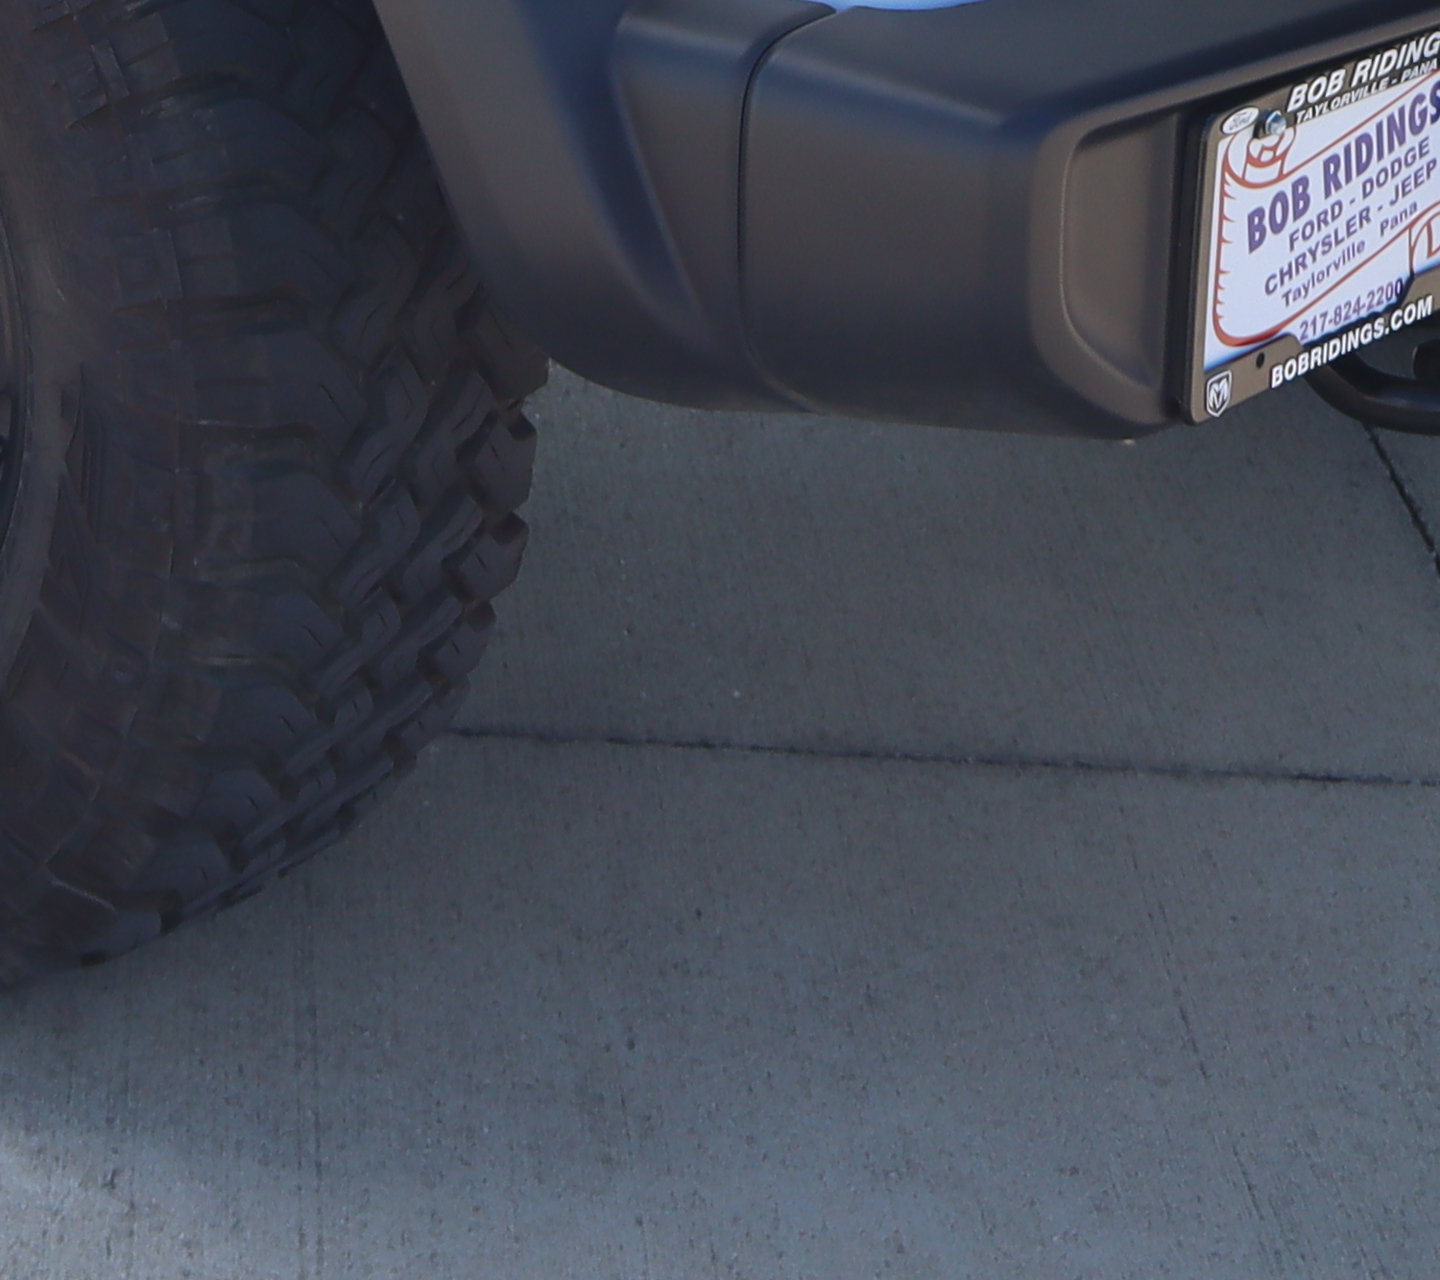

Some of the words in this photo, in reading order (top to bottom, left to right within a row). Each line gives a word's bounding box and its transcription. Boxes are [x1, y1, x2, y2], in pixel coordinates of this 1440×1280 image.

[1287, 68, 1346, 113] BOB
[1295, 77, 1389, 125] TAYLORVILLE
[1401, 58, 1439, 84] PANA
[1247, 174, 1311, 254] BOB
[1264, 205, 1371, 296] CHRYSLER
[1388, 158, 1438, 207] JEEP
[1289, 199, 1343, 252] FORD
[1361, 136, 1430, 200] DODGE
[1281, 240, 1366, 307] Taylorville
[1379, 201, 1418, 237] Pana
[1271, 295, 1434, 389] BOBRIDINGS.COM
[1298, 277, 1404, 341] 217-824-2200
